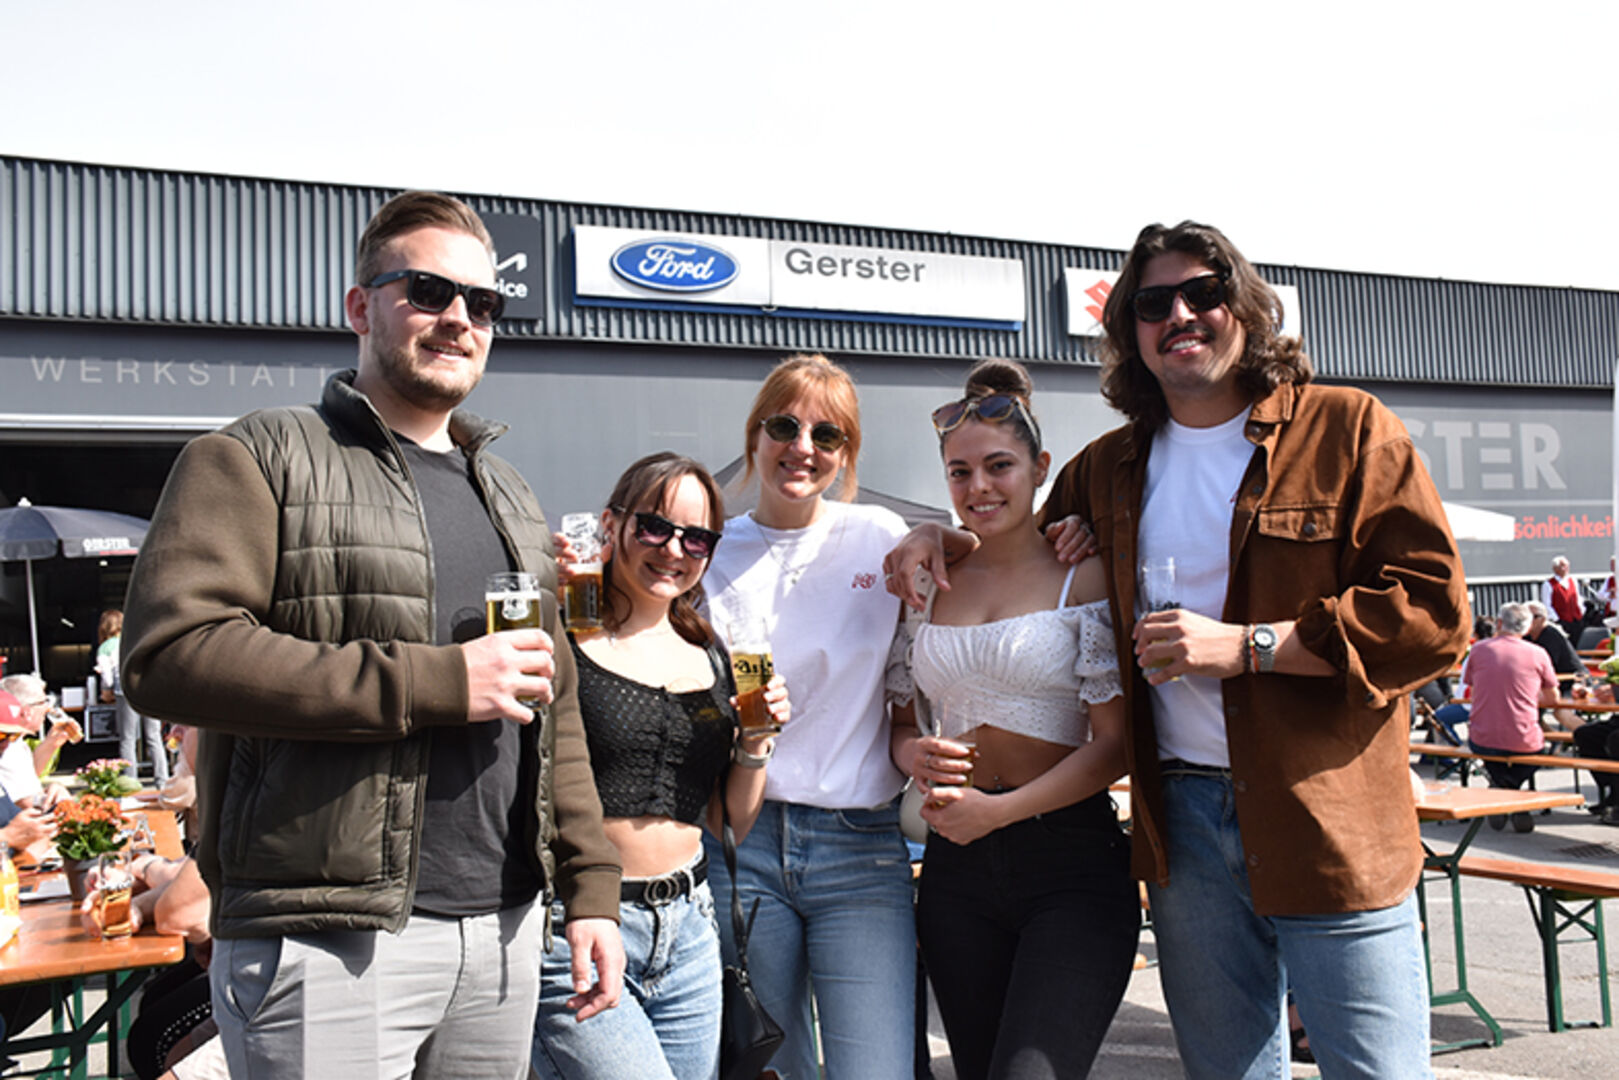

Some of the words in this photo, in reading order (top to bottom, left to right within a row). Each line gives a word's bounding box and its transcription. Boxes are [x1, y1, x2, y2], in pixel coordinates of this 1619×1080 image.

[638, 244, 715, 280] Ford
[785, 247, 926, 283] Gerster
[31, 355, 333, 388] WERKSTATT
